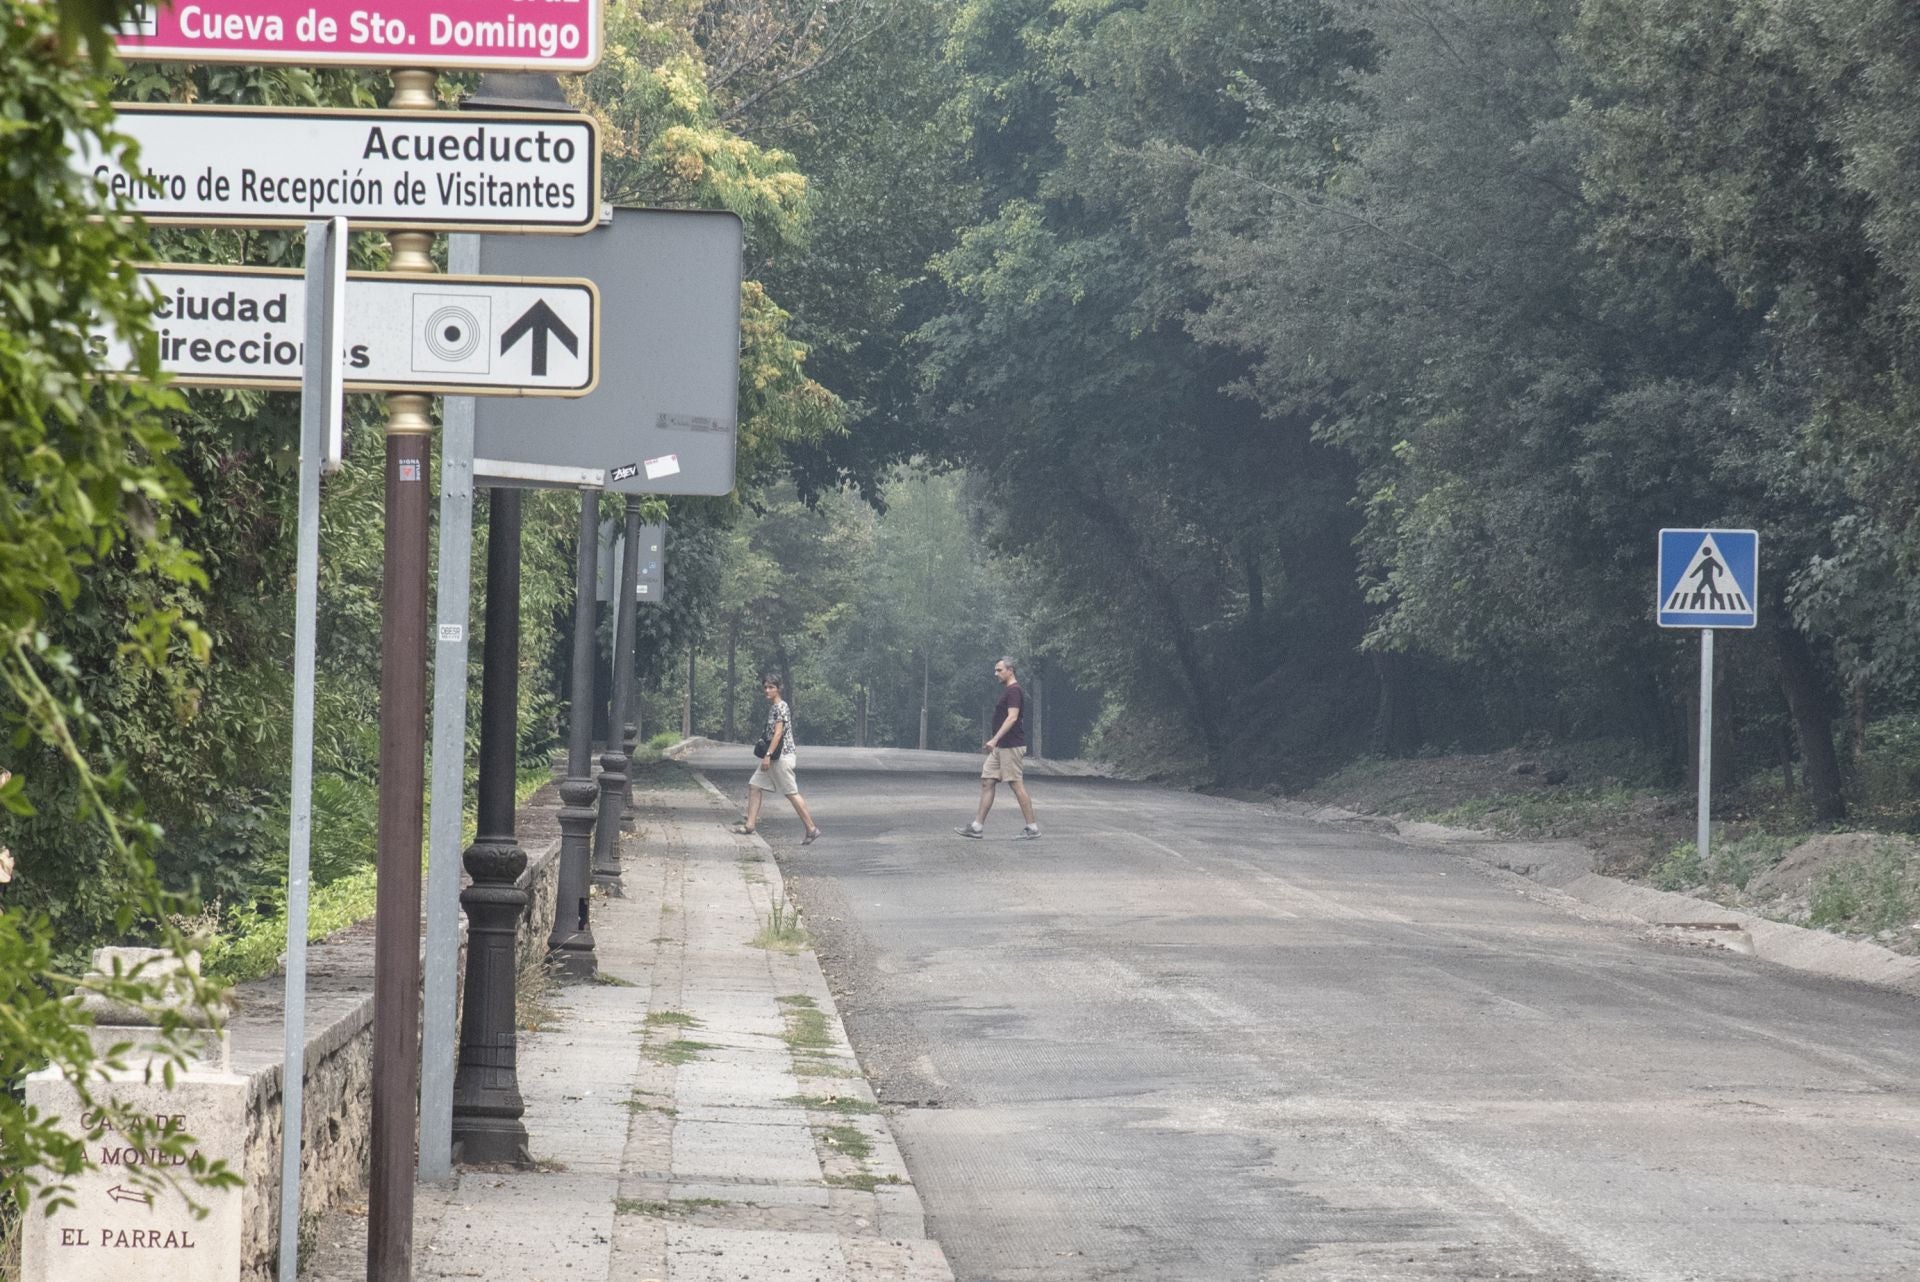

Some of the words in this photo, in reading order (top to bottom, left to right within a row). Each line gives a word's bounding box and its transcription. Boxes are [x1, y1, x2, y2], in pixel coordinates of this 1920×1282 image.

[179, 6, 284, 41] Cueva
[296, 9, 338, 42] de
[350, 11, 416, 45] Sto.
[430, 13, 580, 56] Domingo
[362, 126, 576, 163] Acueducto
[197, 166, 230, 201] de
[242, 168, 383, 212] Recepción
[394, 170, 426, 205] de
[436, 171, 575, 209] Visitantes
[153, 287, 287, 323] ciudad
[157, 328, 370, 369] ireccios
[155, 1113, 186, 1132] DE
[61, 1228, 89, 1247] EL
[101, 1229, 195, 1249] PARRAL
